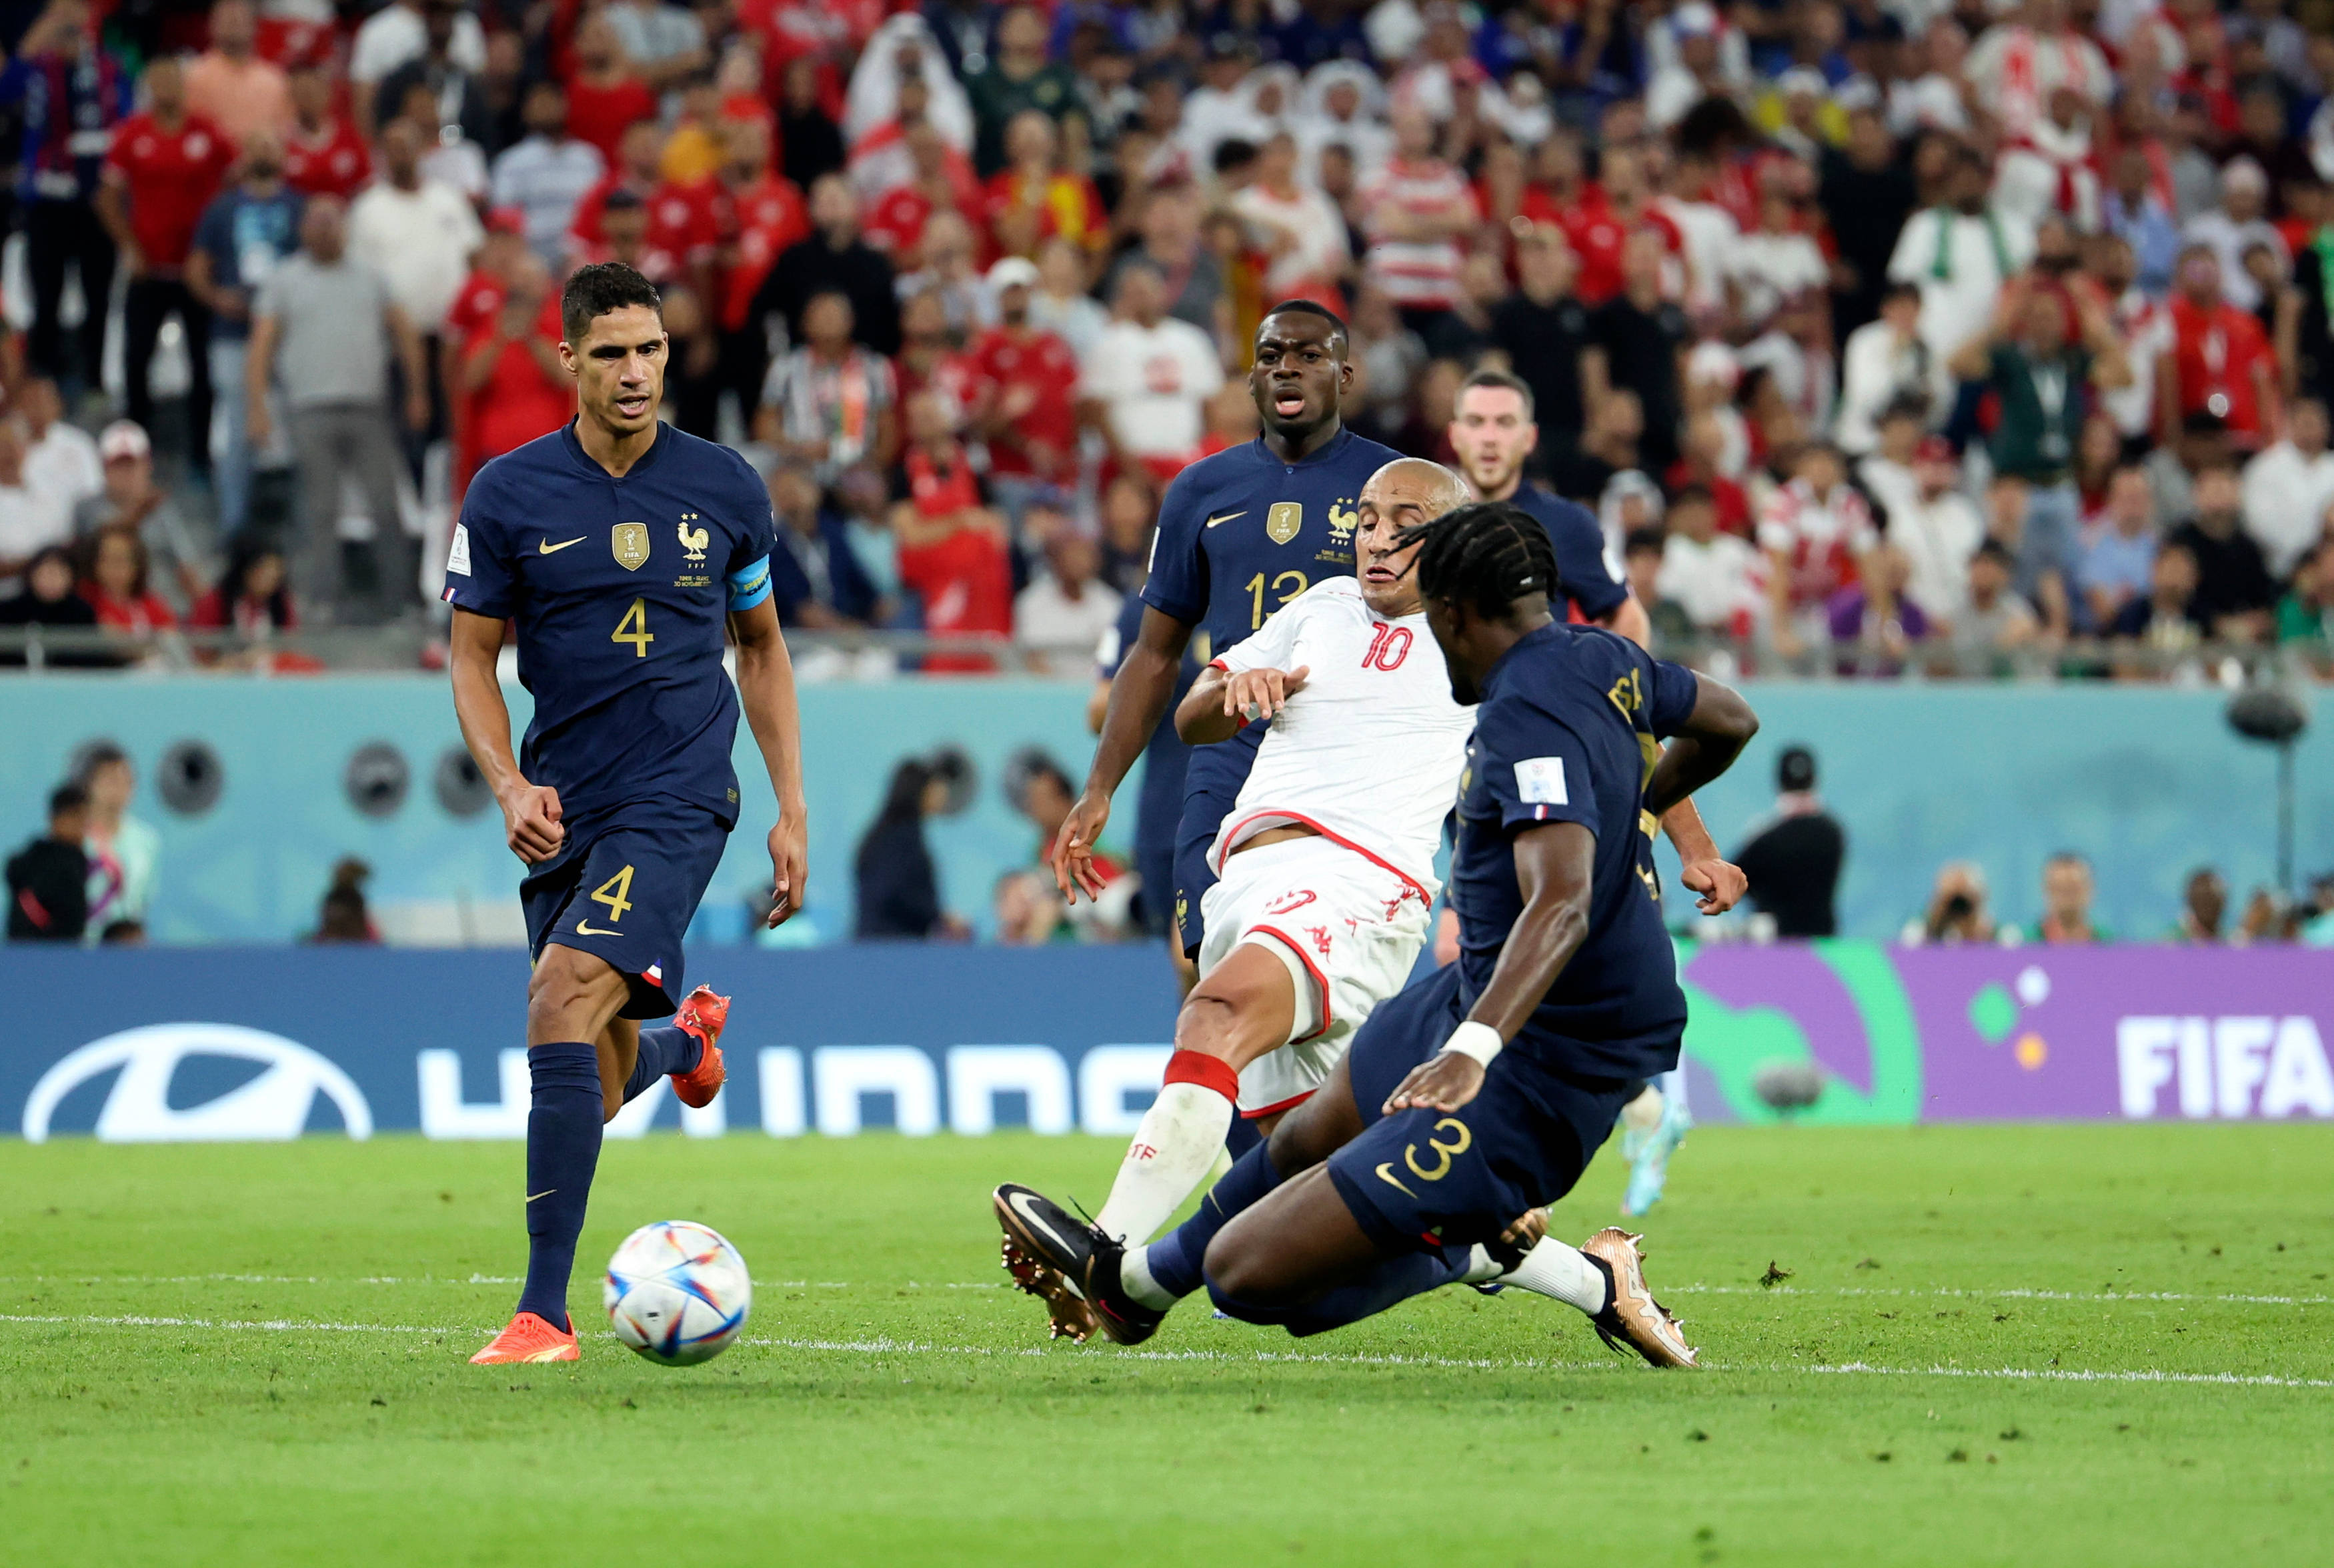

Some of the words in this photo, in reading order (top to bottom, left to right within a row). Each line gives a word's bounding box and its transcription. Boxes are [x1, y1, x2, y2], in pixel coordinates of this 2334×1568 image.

[611, 597, 654, 657] 4
[1361, 621, 1414, 671] 10
[591, 864, 634, 923] 4
[2116, 1015, 2334, 1119] FIFA
[1131, 1143, 1157, 1160] TF
[1404, 1117, 1472, 1182] 3
